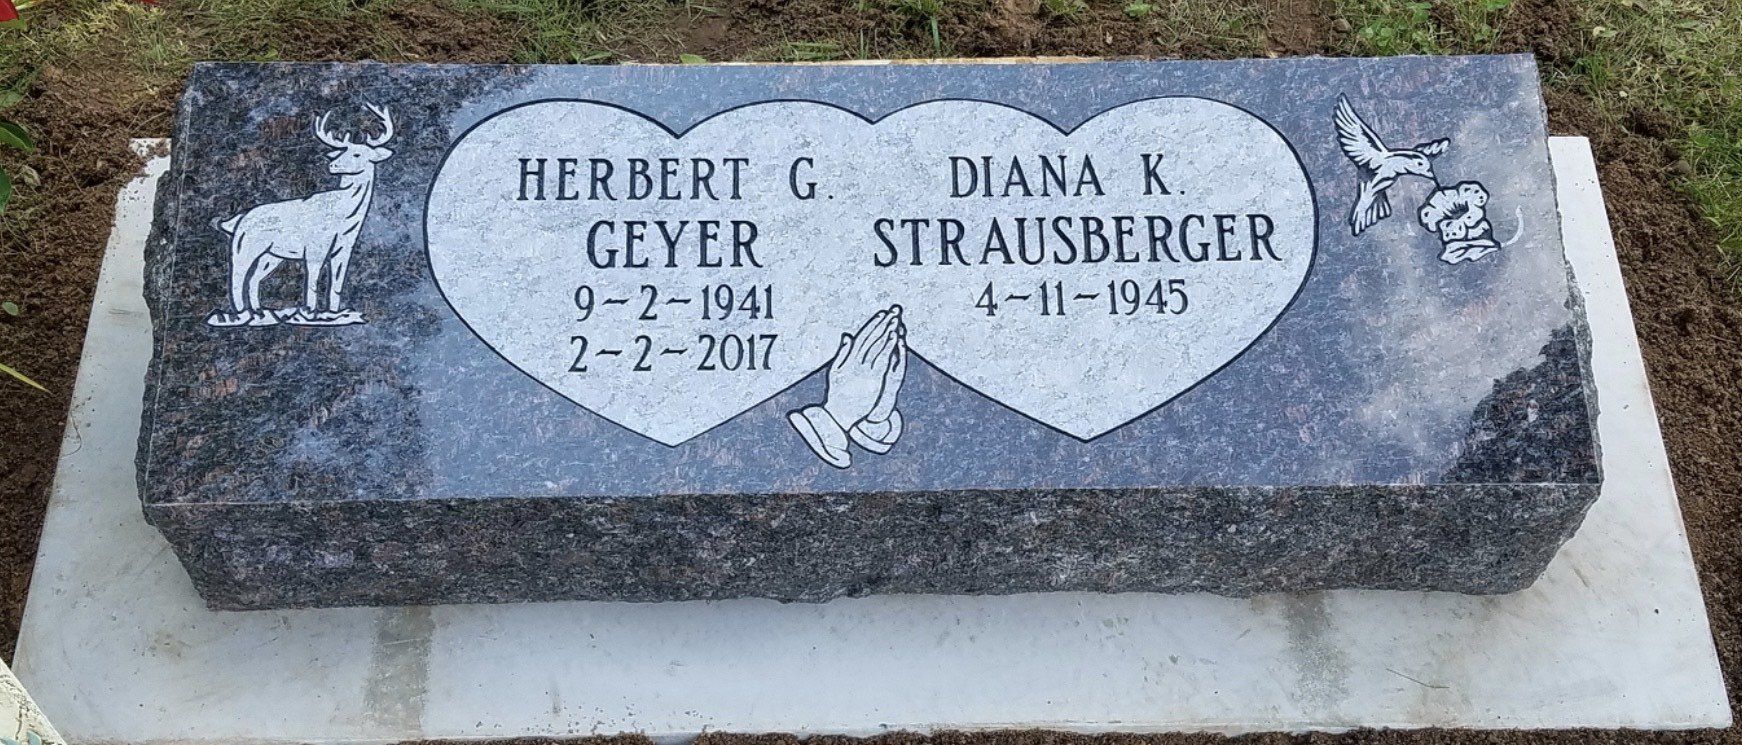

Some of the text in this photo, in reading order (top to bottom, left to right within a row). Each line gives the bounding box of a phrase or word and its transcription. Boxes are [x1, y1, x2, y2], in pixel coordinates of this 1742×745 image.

[517, 157, 835, 201] HERBERT G.
[949, 153, 1186, 199] DIANA K.
[586, 220, 764, 269] GEYER
[873, 213, 1283, 268] STRAUSBERGER
